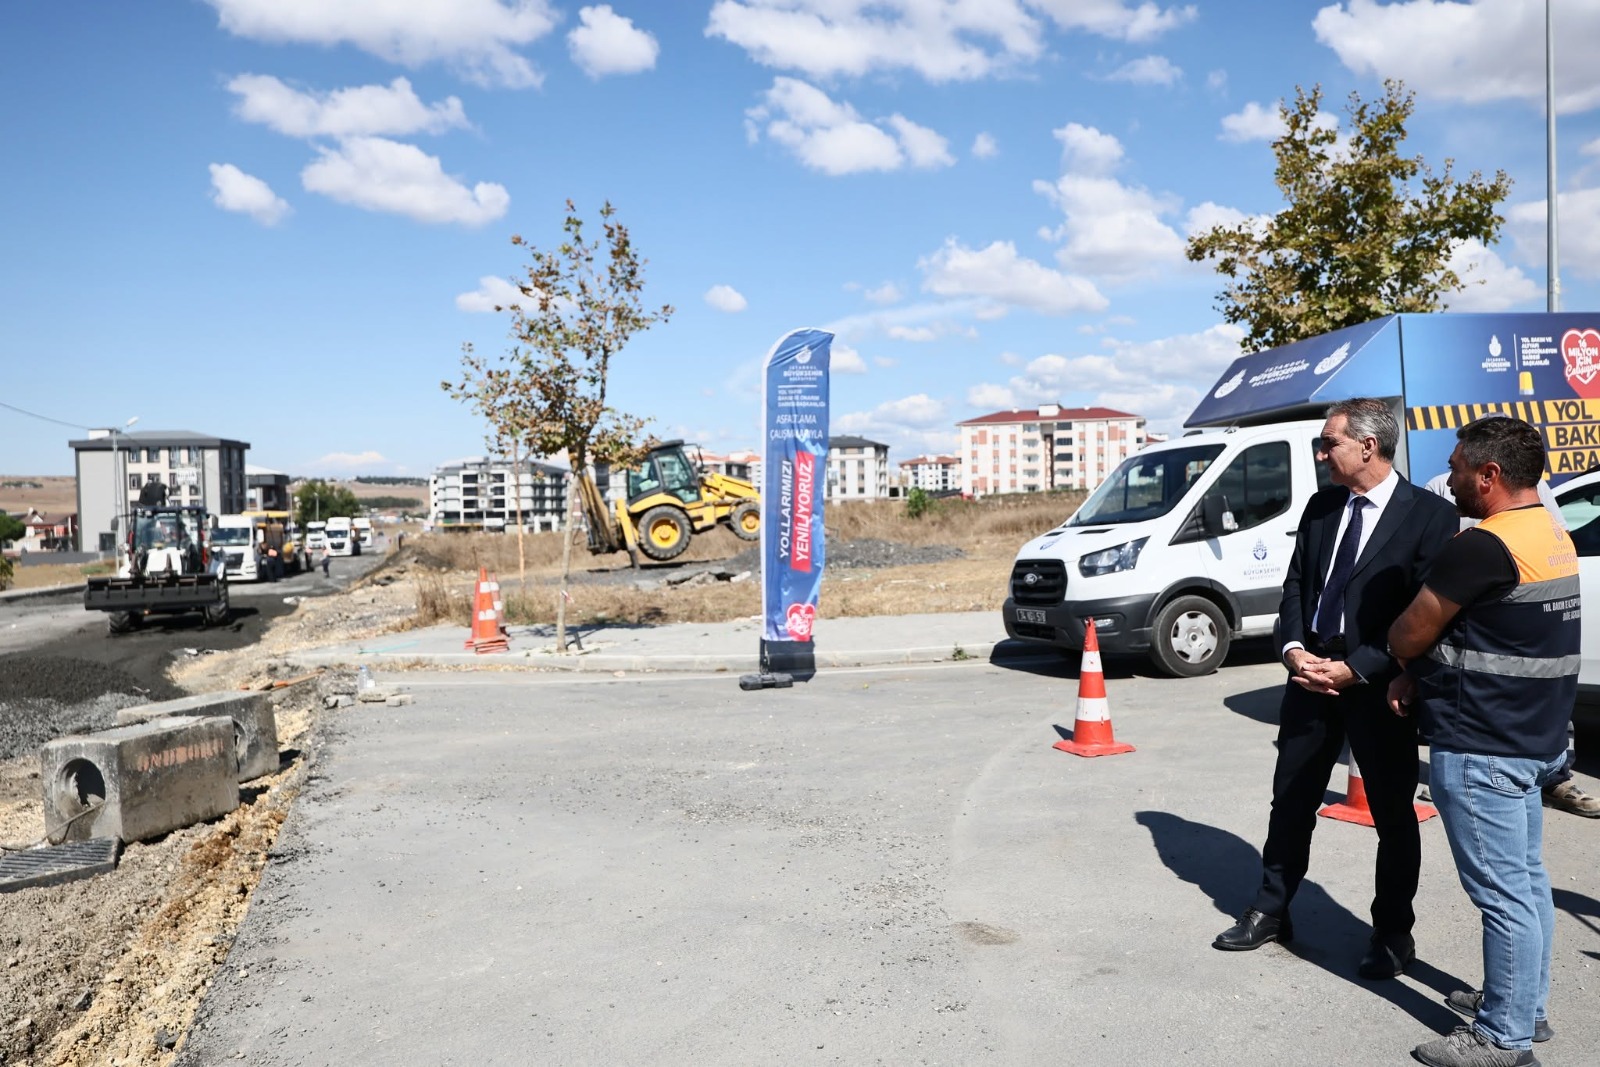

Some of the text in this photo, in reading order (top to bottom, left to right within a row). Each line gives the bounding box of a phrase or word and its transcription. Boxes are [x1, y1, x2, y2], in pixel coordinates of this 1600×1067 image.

[1578, 339, 1587, 347] 16
[1566, 362, 1600, 381] Çalışıyoru
[1552, 400, 1593, 421] YOL
[1557, 450, 1600, 472] ARA
[779, 460, 792, 558] YOLLARIMIZI
